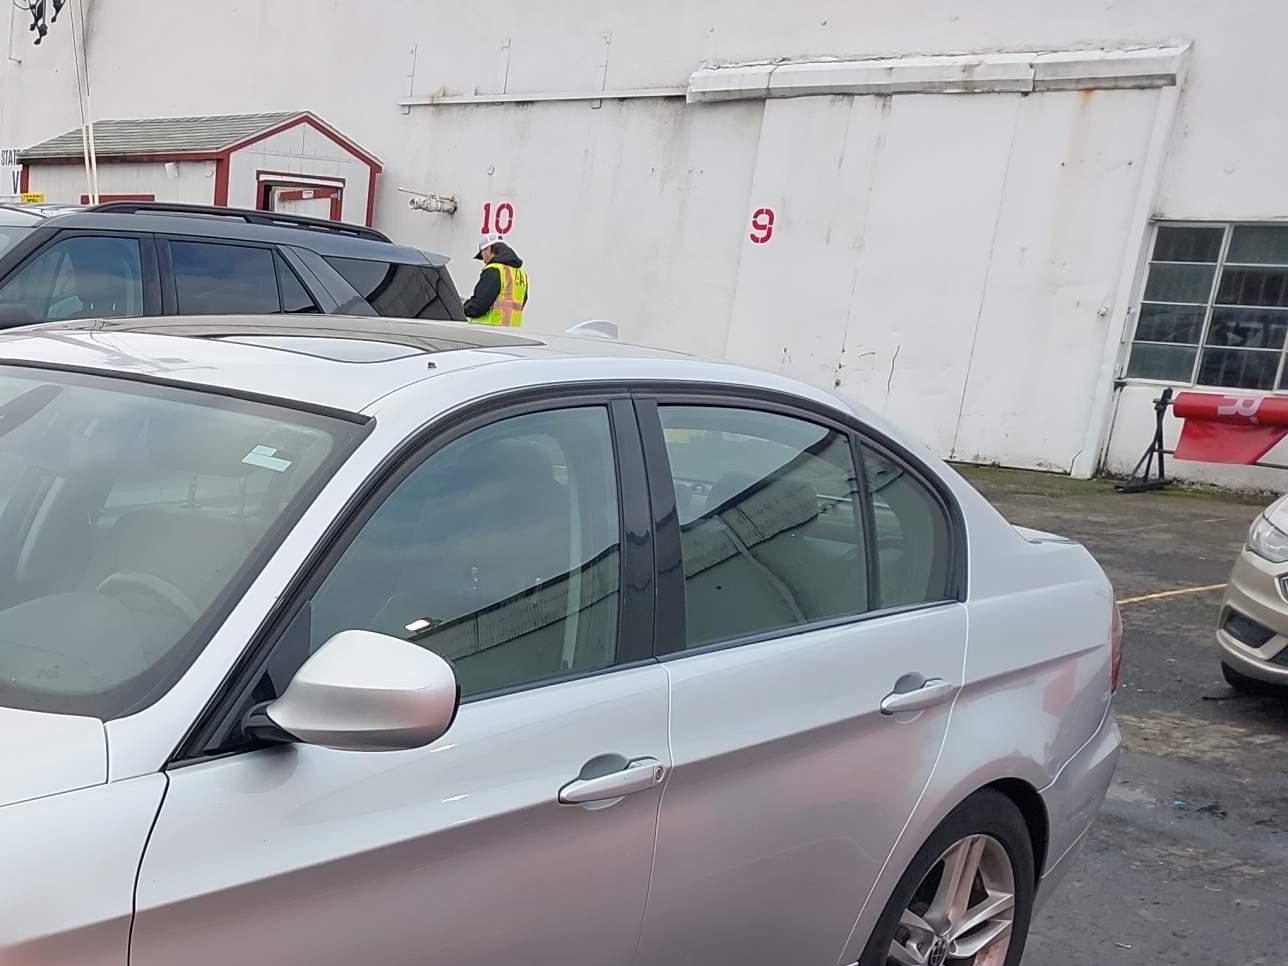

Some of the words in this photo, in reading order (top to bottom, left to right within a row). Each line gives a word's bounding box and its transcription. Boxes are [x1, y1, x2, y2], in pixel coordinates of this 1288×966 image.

[1, 149, 21, 166] STAT
[481, 203, 513, 235] 10
[750, 208, 775, 244] 9
